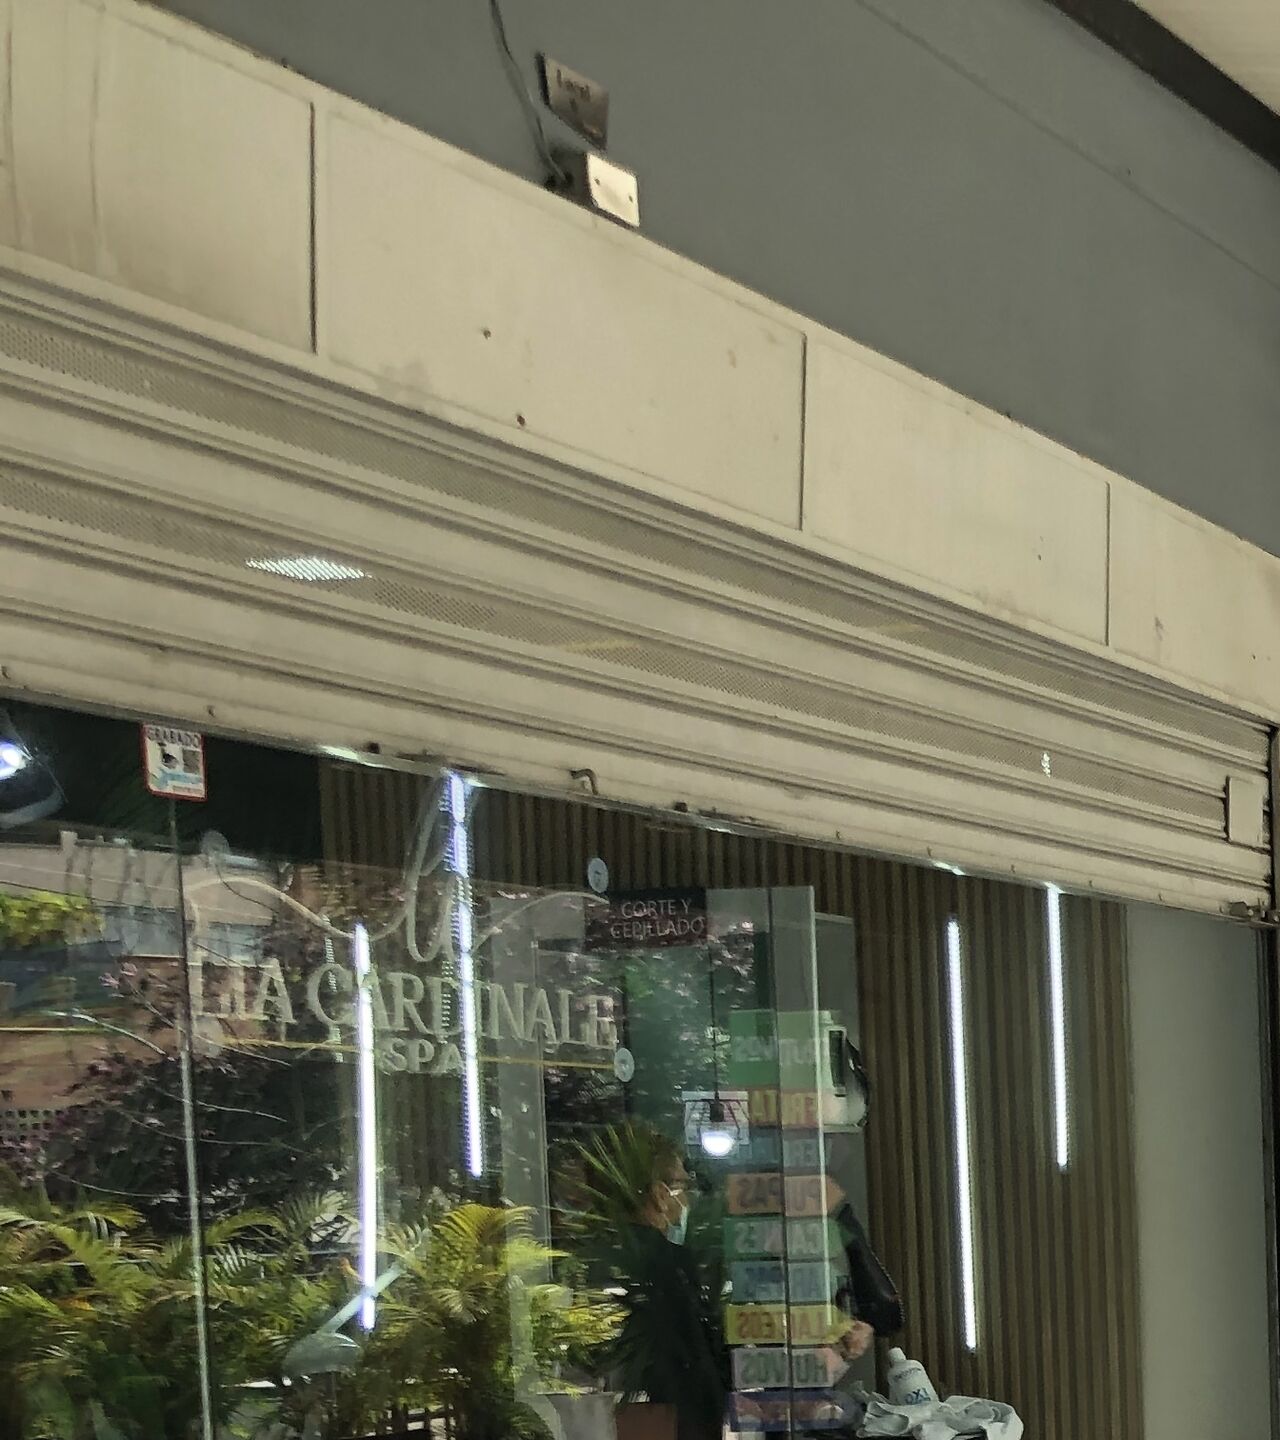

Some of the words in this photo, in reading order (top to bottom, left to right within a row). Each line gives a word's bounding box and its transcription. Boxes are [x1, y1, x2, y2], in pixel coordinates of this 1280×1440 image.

[621, 899, 676, 919] CORTE
[681, 898, 692, 915] Y
[307, 963, 619, 1051] CARDINALE
[376, 1036, 467, 1075] SPA
